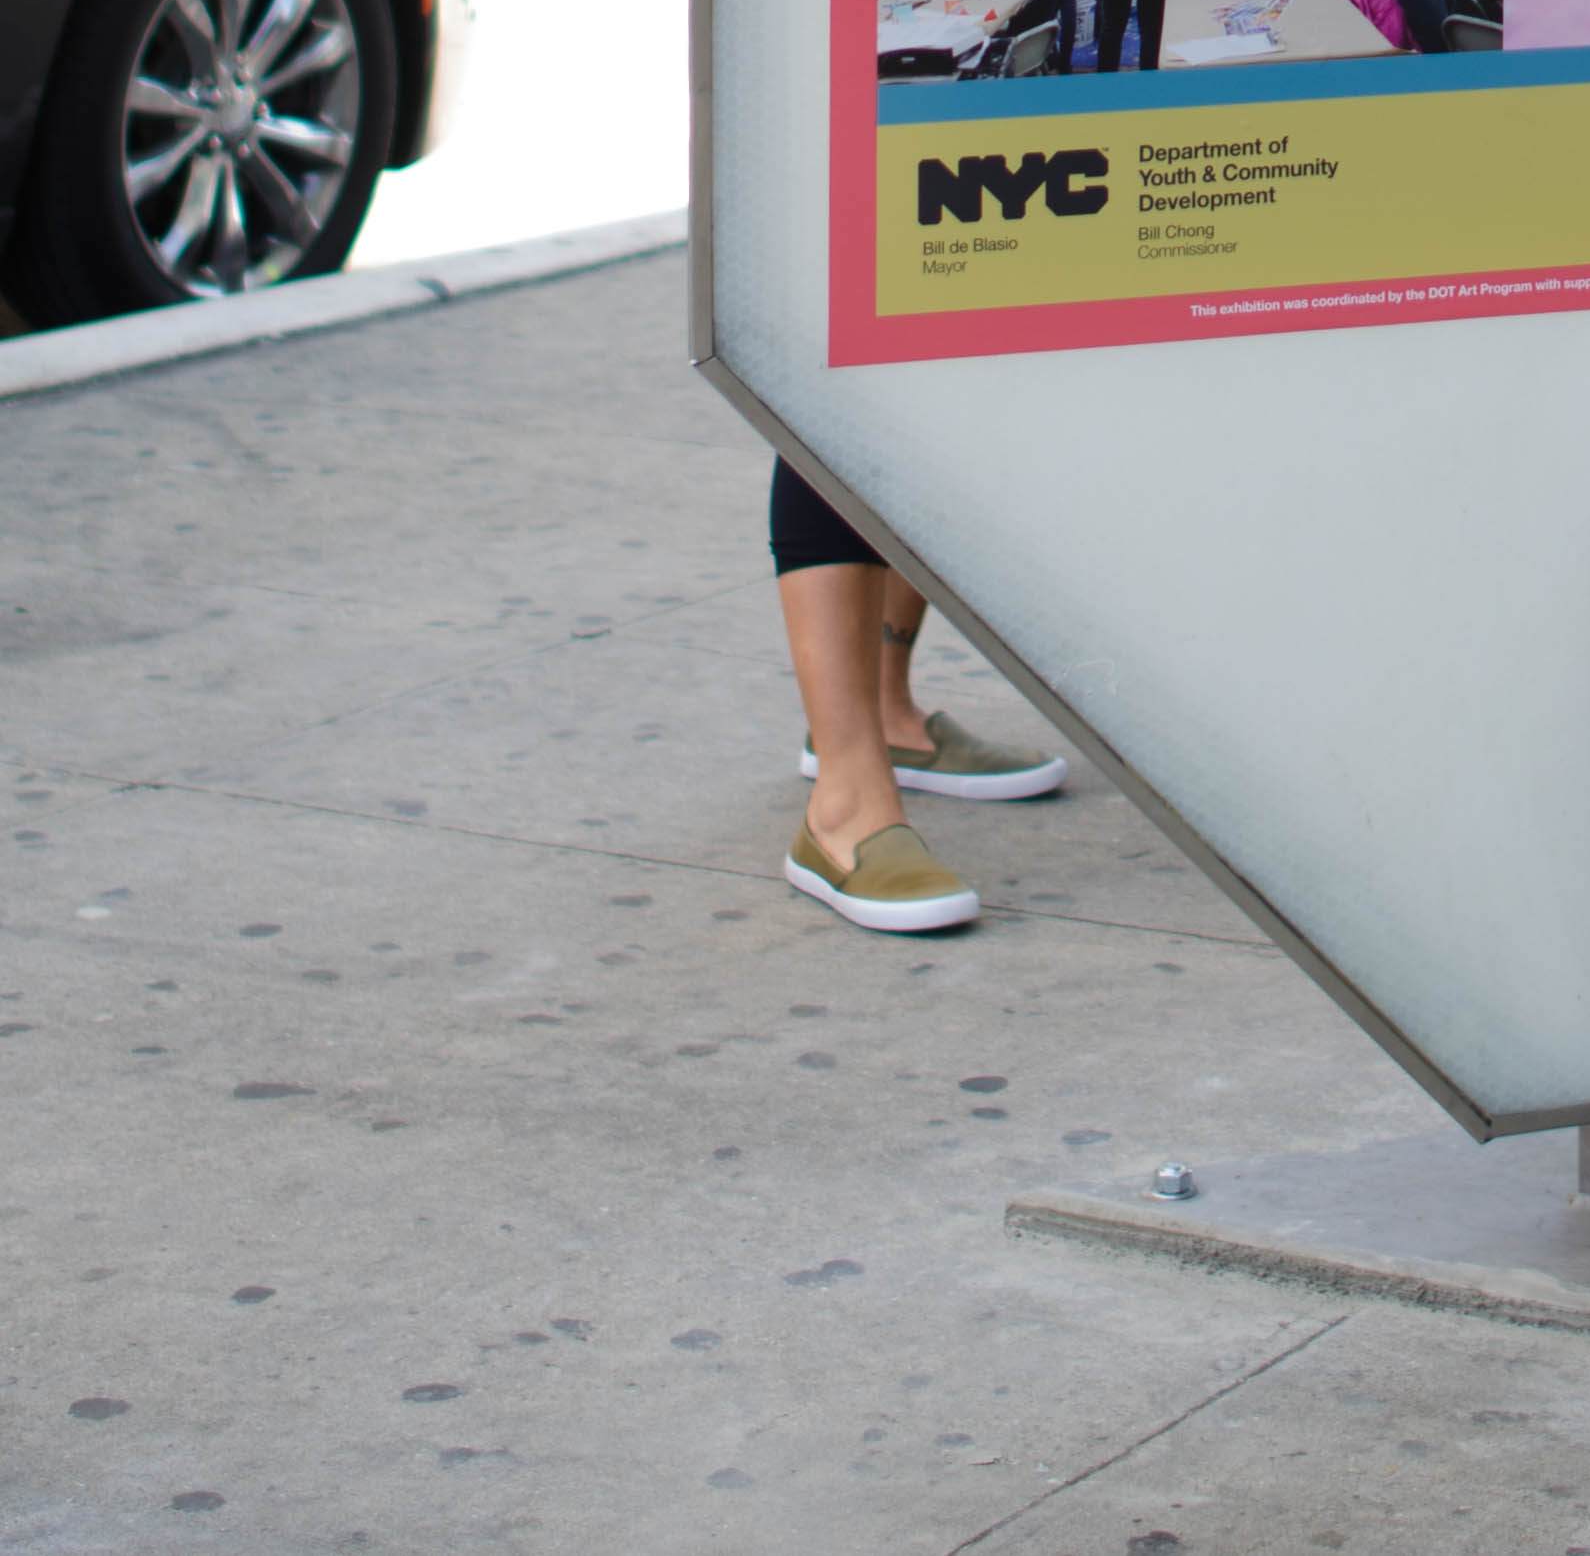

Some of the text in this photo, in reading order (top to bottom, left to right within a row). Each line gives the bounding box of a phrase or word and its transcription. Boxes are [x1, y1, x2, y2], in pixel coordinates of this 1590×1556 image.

[1138, 134, 1289, 166] Department of
[916, 147, 1109, 226] NYC
[1137, 157, 1339, 188] Youth & Community
[1138, 185, 1277, 213] Development
[922, 236, 1019, 257] Bill de Blasio
[1137, 224, 1215, 242] Bill Chong
[1137, 239, 1238, 260] Commissioner
[921, 255, 968, 277] Mayor
[1189, 303, 1218, 318] This
[1218, 298, 1281, 316] exhibition
[1282, 298, 1309, 310] was
[1310, 289, 1386, 309] coordinated
[1386, 289, 1404, 304] by
[1404, 288, 1426, 302] the
[1427, 284, 1457, 300] DOT
[1457, 283, 1478, 297] Art
[1479, 281, 1533, 297] Program
[1534, 277, 1561, 293] with
